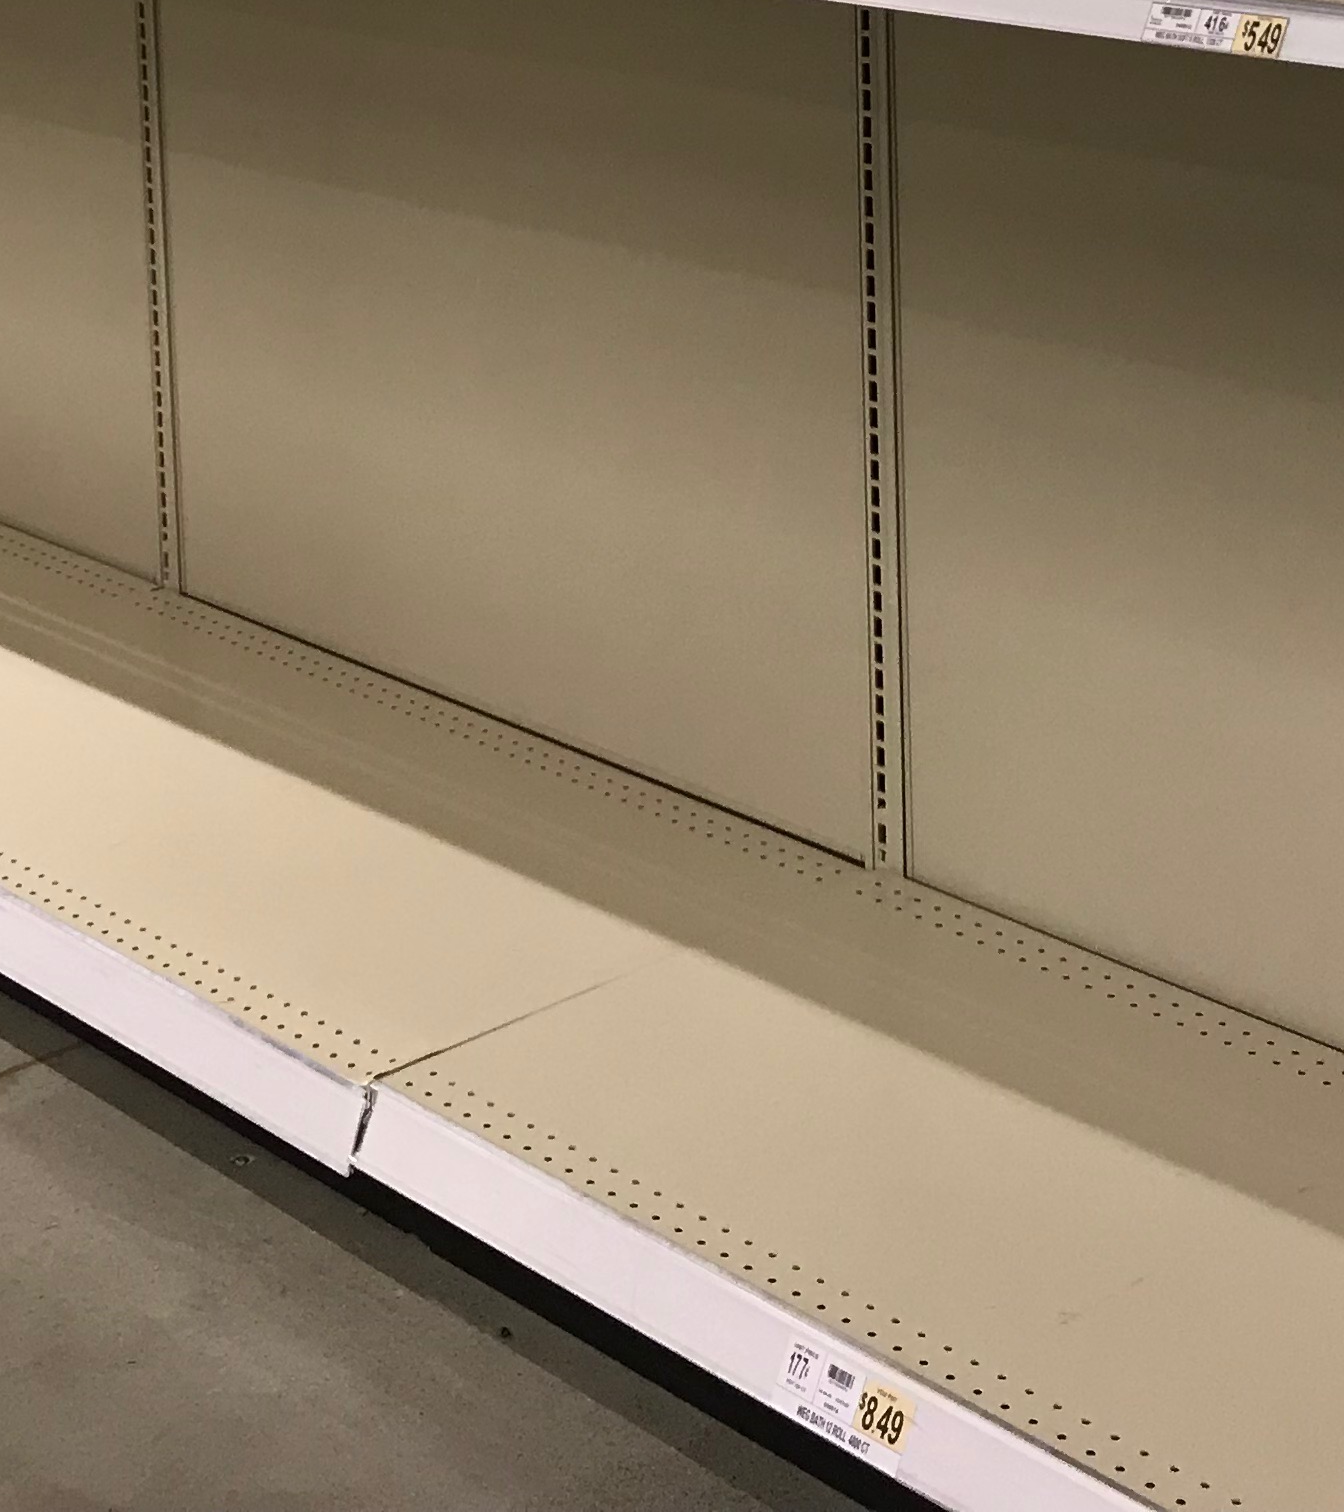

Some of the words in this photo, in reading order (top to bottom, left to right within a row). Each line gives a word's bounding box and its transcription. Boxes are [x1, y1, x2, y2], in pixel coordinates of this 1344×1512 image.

[810, 1412, 826, 1428] BATH
[832, 1424, 846, 1442] ROLL
[858, 1392, 904, 1445] $8.49
